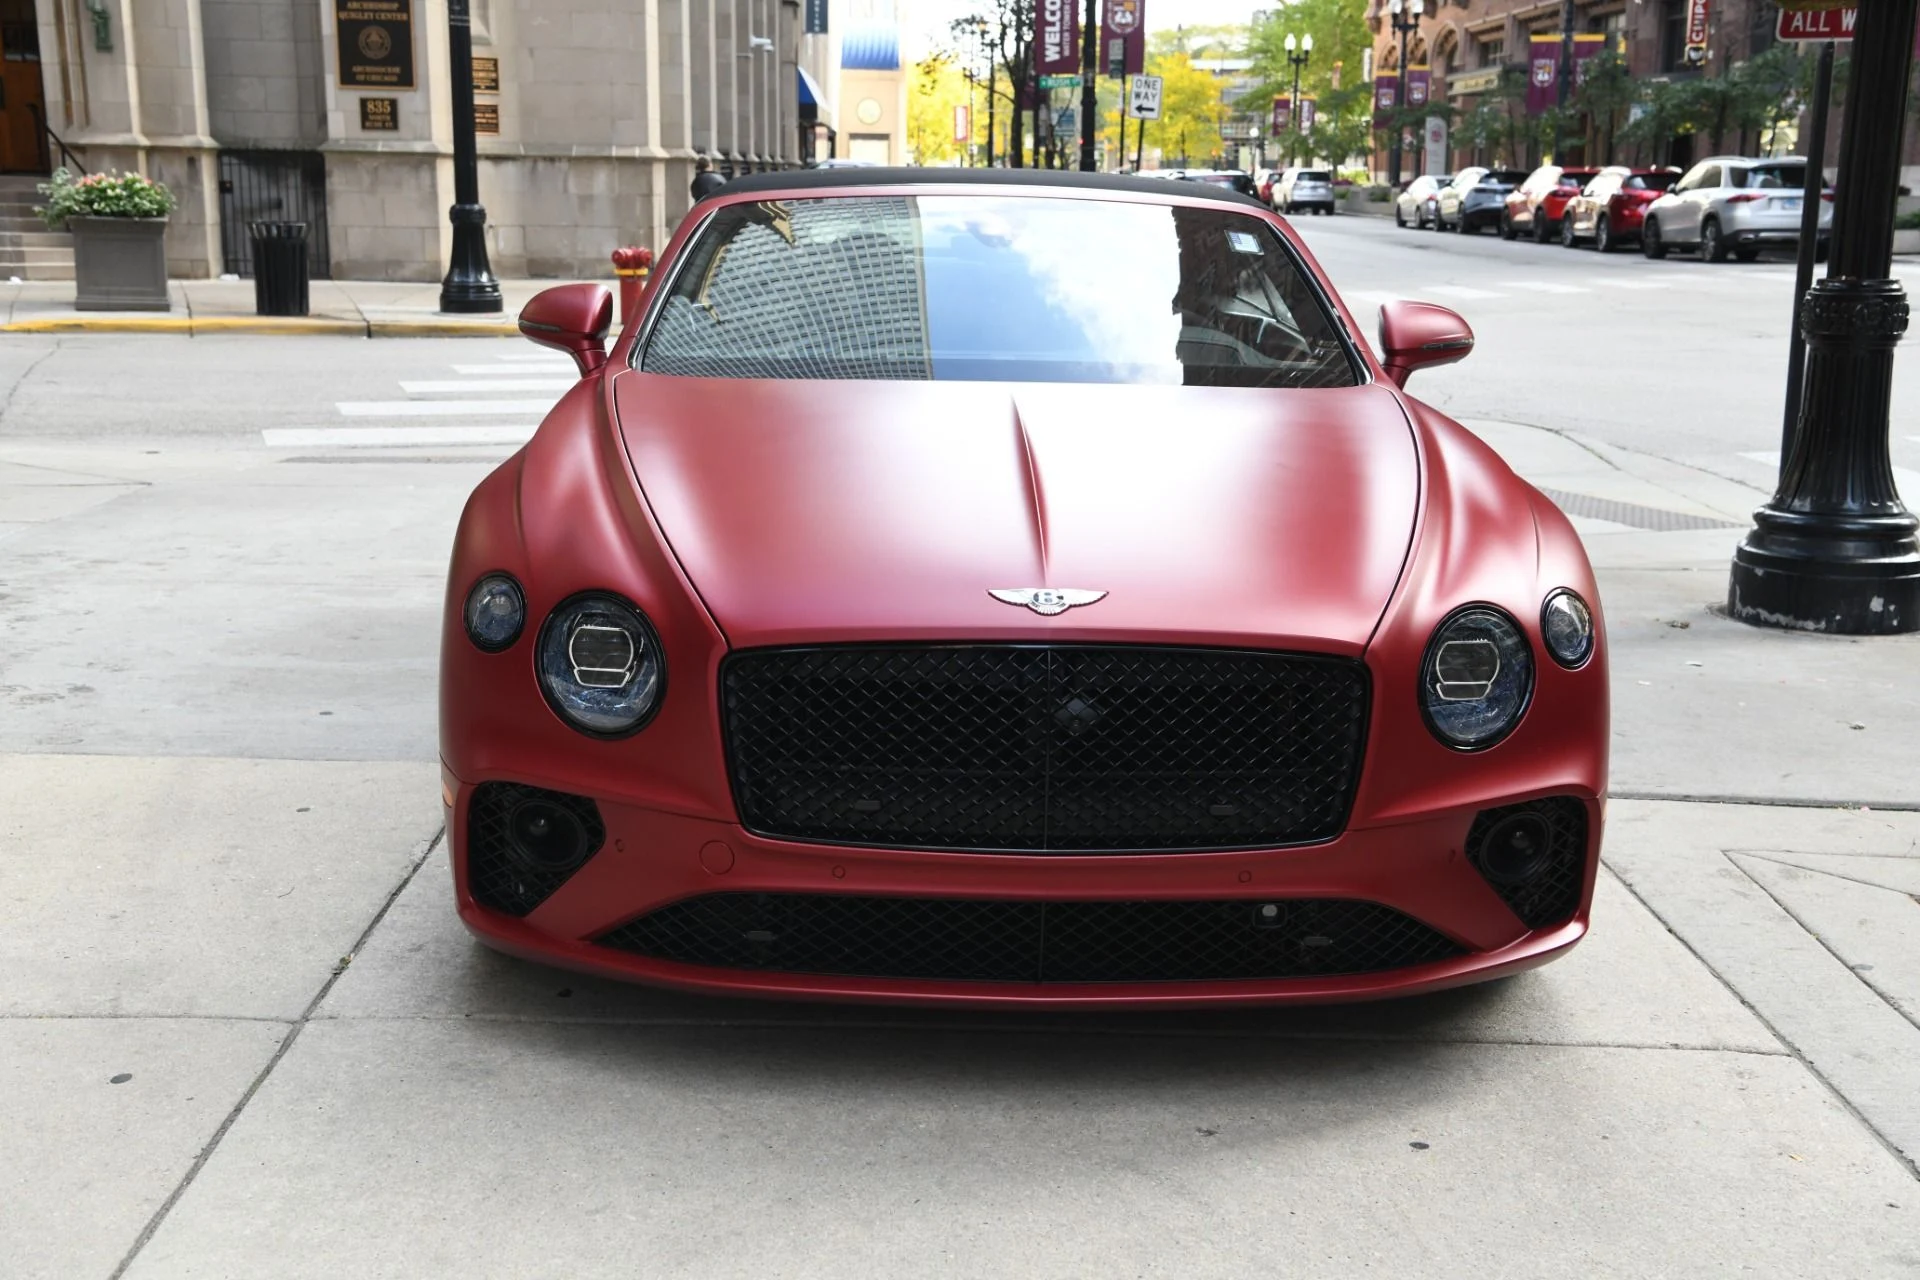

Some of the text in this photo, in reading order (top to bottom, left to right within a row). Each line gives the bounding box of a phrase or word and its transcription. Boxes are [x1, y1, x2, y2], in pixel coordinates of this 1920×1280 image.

[375, 12, 408, 20] CENTER
[1062, 5, 1071, 30] TOWER
[1790, 11, 1831, 32] ALL
[1062, 32, 1070, 57] WATER
[1047, 78, 1070, 88] RUSH
[1135, 80, 1158, 90] ONE
[1134, 92, 1158, 102] WAY
[367, 100, 391, 114] 835
